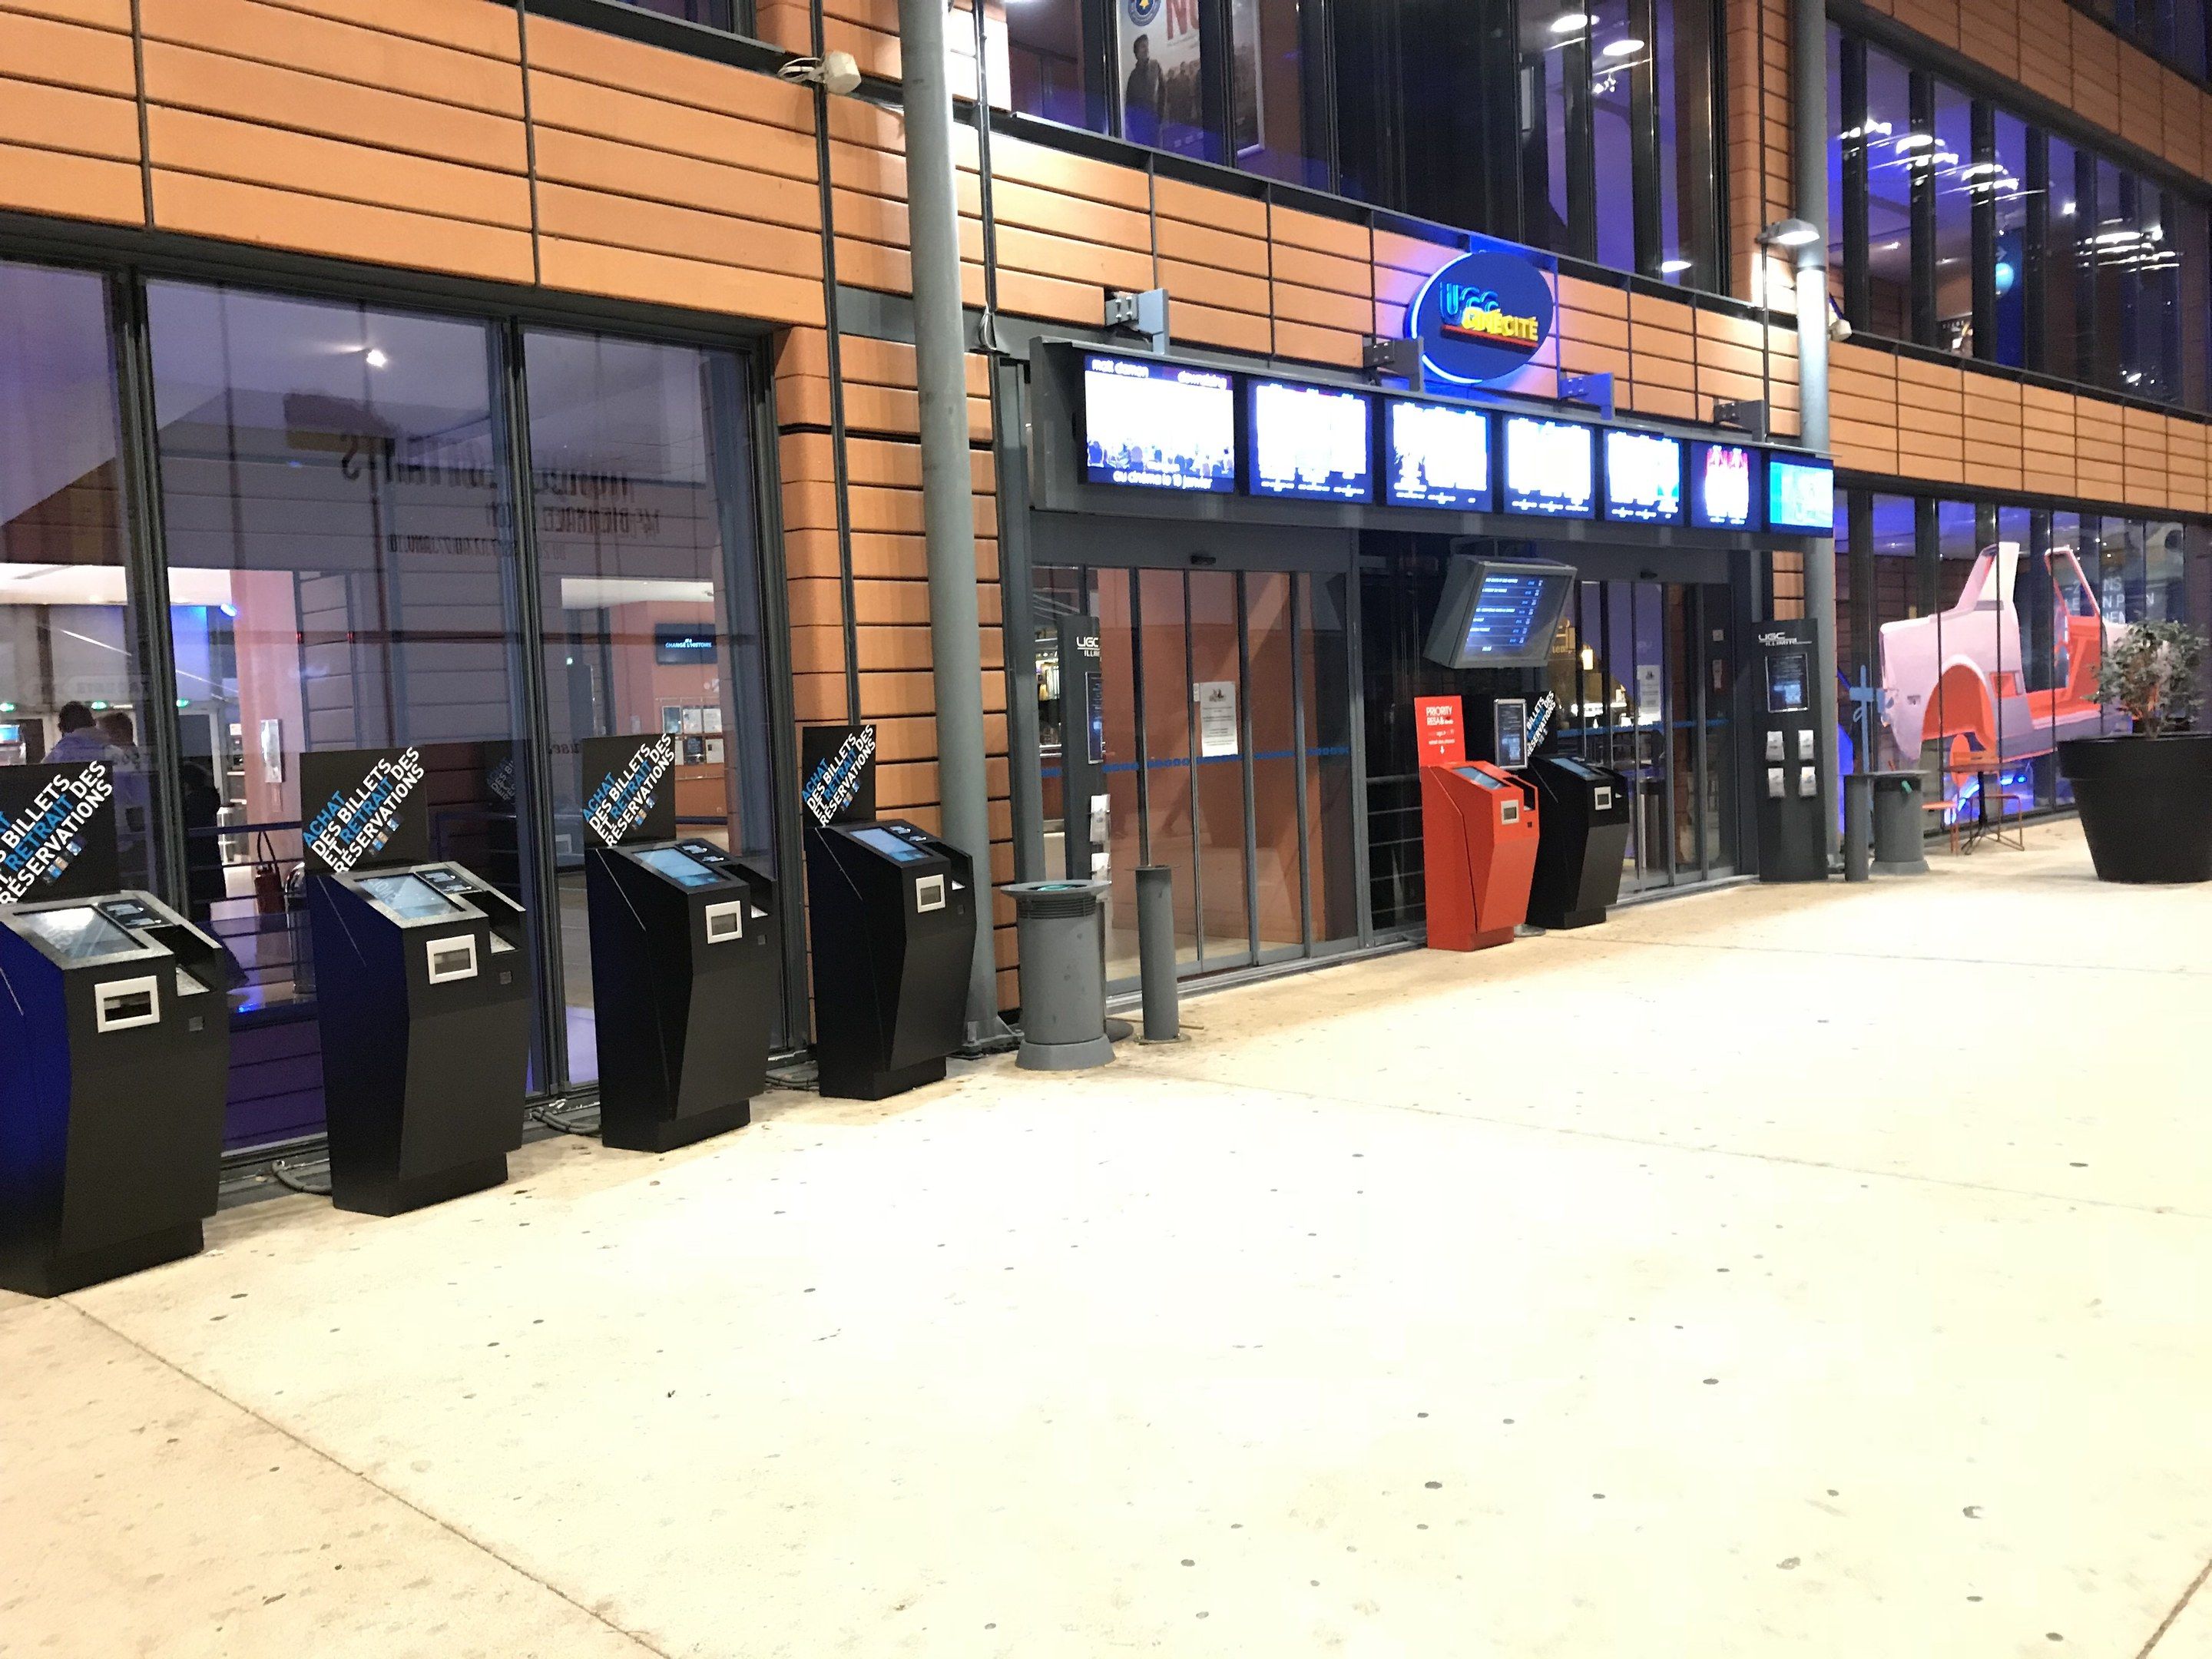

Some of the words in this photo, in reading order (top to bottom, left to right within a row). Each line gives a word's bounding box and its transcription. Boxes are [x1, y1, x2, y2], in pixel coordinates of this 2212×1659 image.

[1462, 306, 1539, 342] CINÉCITÉ
[1076, 637, 1098, 647] UGC
[1426, 706, 1452, 716] PRIORITY
[1, 773, 70, 849] BILLETS
[311, 820, 342, 857] DES
[336, 758, 392, 824] BILLETS
[322, 840, 343, 867] ET
[339, 776, 393, 845] RETRAIT
[390, 747, 419, 780] DES
[583, 772, 615, 823] ACHAT
[589, 799, 612, 831] DES
[608, 743, 651, 802] BILLETS
[598, 816, 614, 839] ET
[610, 759, 652, 820] RETRAIT
[649, 733, 671, 763] DES
[605, 748, 674, 847] RÉSERVATIONS
[802, 757, 829, 803] ACHAT
[806, 782, 825, 810] DES
[823, 733, 856, 784] BILLETS
[813, 798, 826, 819] ET
[823, 747, 857, 801] RETRAIT
[855, 724, 873, 752] DES
[819, 738, 876, 827] RÉSERVATIONS
[4, 793, 74, 872] RETRAIT
[69, 760, 105, 799] DES
[303, 790, 345, 848] ACHAT
[333, 763, 425, 873] RÉSERVATIONS
